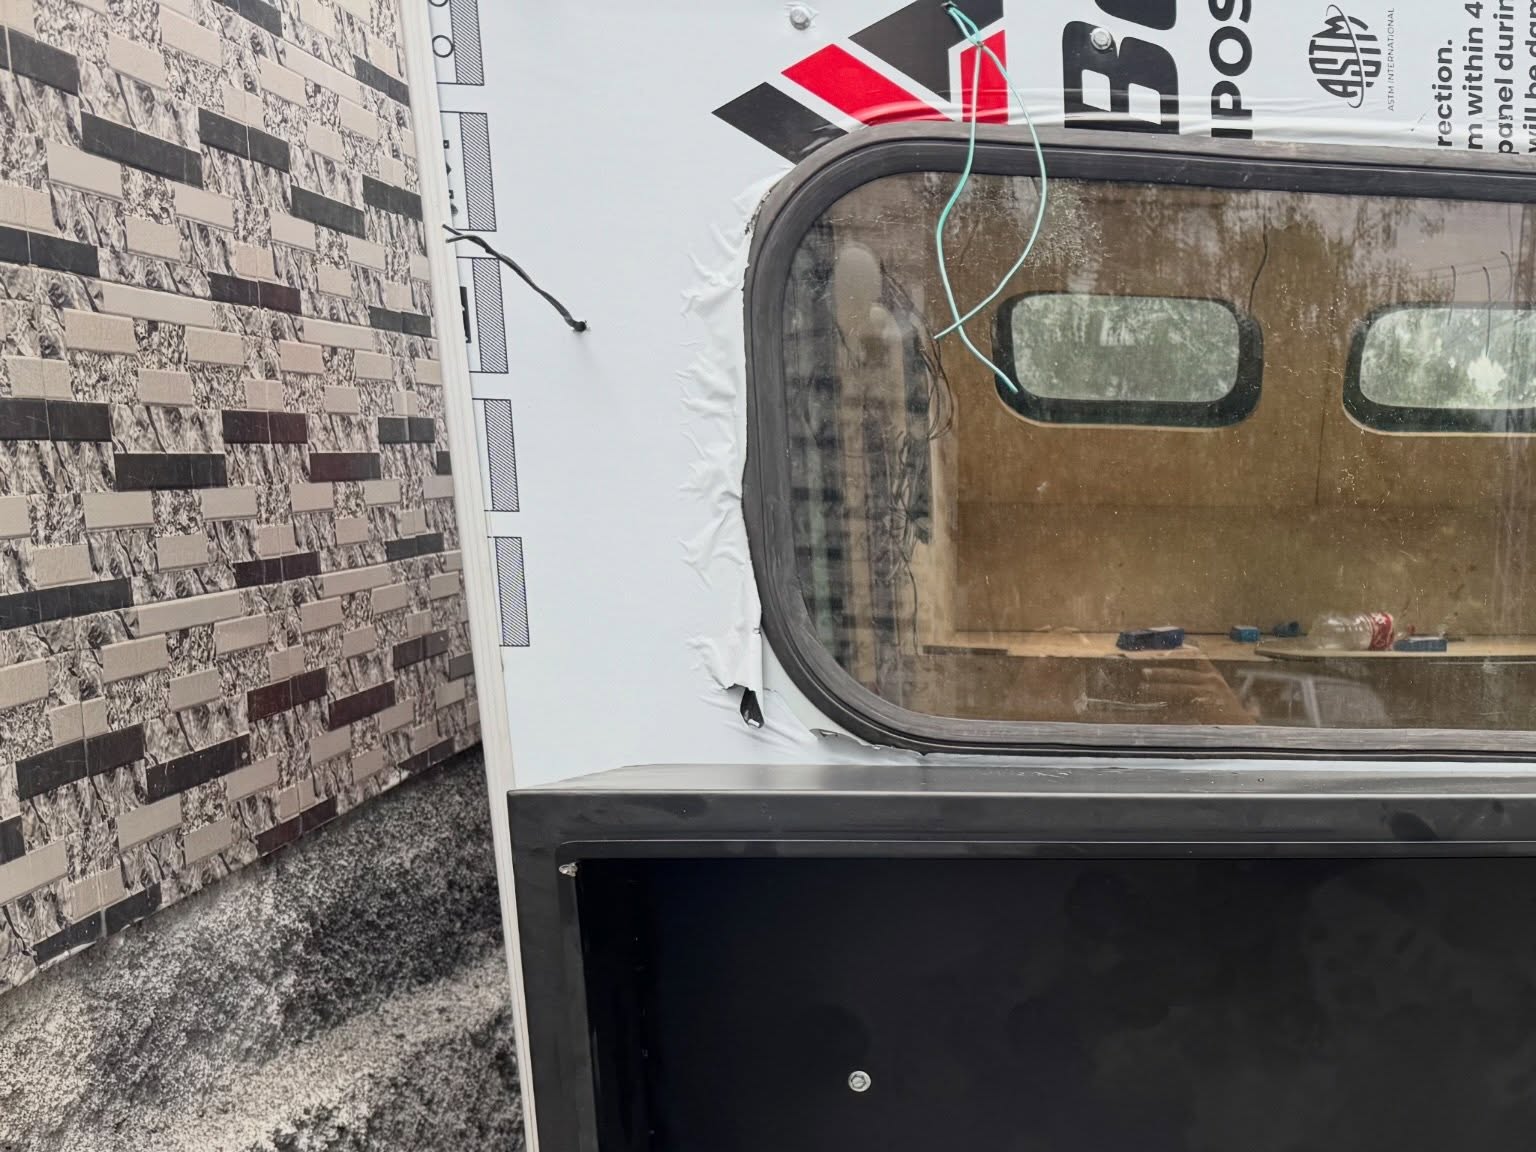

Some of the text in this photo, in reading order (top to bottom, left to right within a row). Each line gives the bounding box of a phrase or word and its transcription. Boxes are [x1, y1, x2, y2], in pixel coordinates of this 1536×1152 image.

[1209, 0, 1254, 139] POS
[1308, 14, 1382, 98] ASTM
[1387, 7, 1395, 112] ASTM INTERNATIONAL
[1462, 27, 1484, 116] within
[1494, 78, 1521, 155] panel
